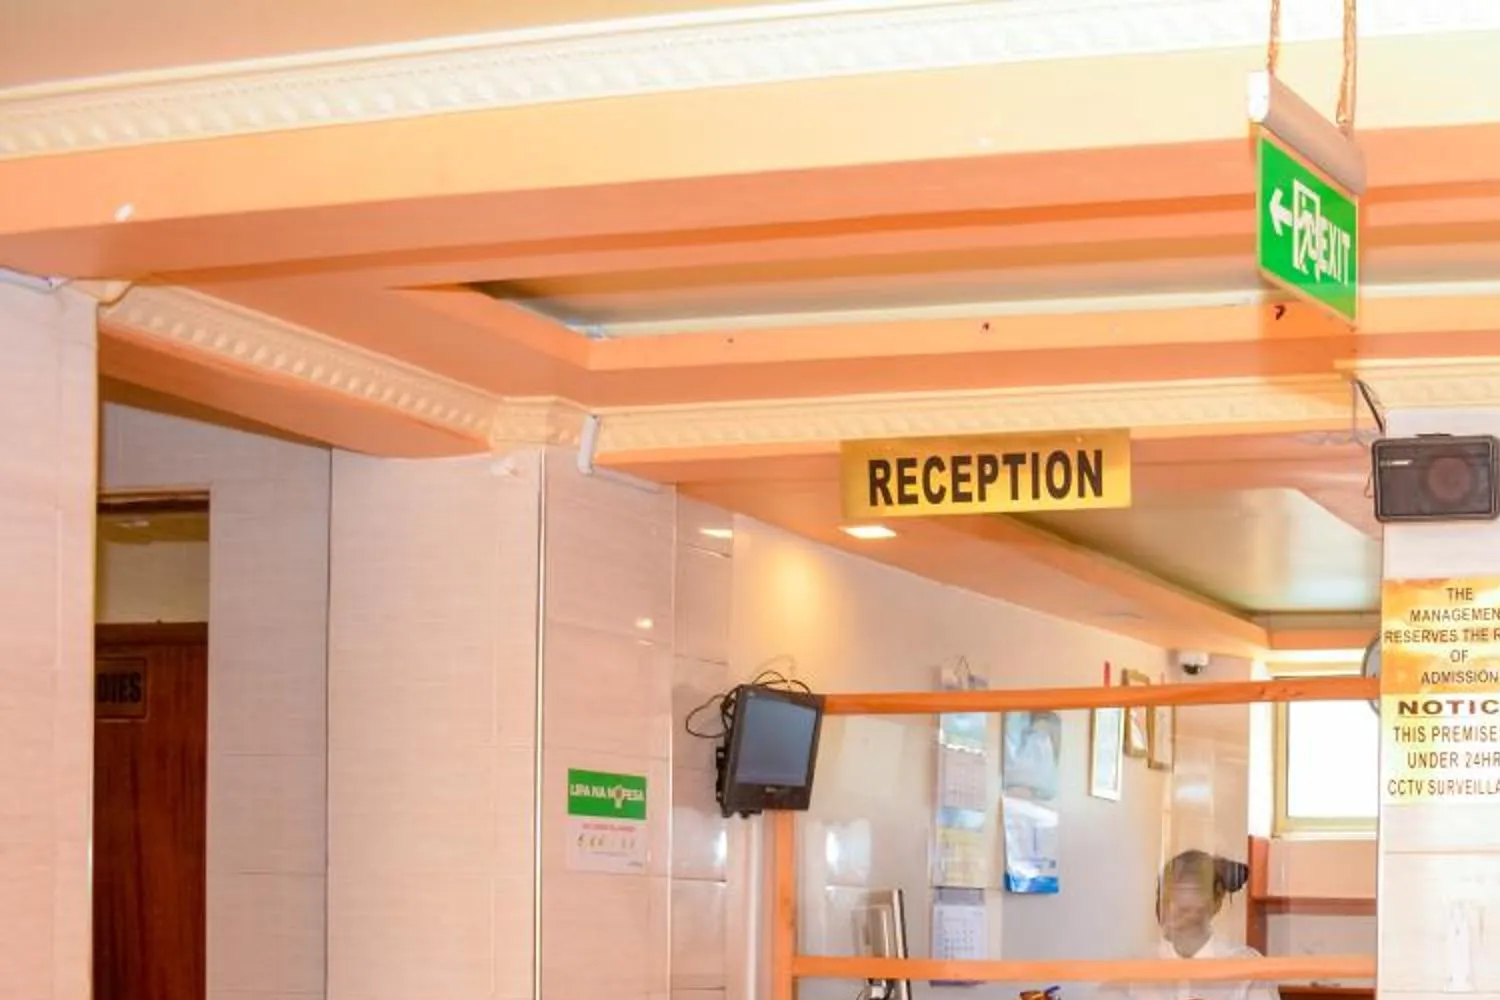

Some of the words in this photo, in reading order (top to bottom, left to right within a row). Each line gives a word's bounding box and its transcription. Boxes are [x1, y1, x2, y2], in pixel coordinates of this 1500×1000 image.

[1318, 216, 1351, 287] EXIT
[868, 449, 1103, 506] RECEPTION
[1446, 587, 1474, 601] THE
[1384, 629, 1458, 643] RESERVES
[1462, 628, 1489, 642] THE
[1449, 649, 1469, 663] OF
[1420, 670, 1499, 685] ADMISSION
[96, 672, 142, 703] DIES
[1393, 725, 1426, 743] THIS
[1407, 751, 1459, 769] UNDER
[1387, 779, 1424, 796] CCTV
